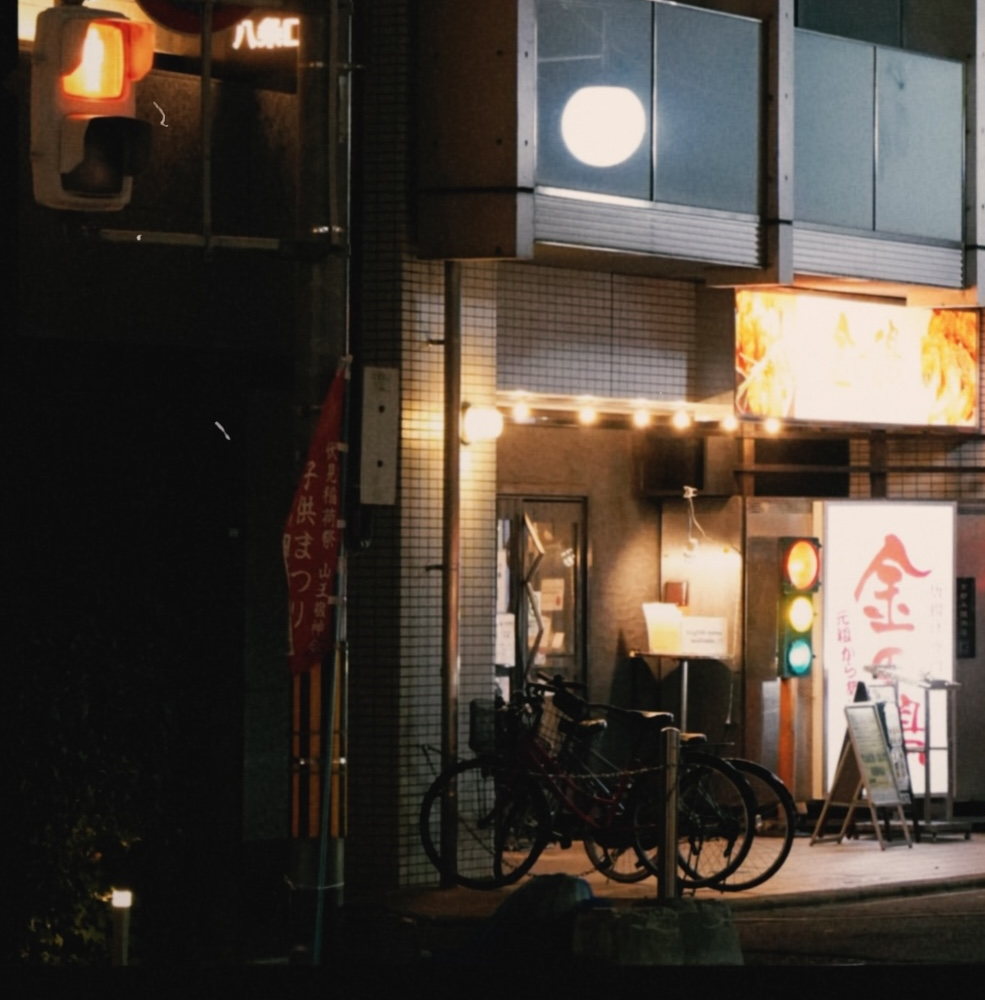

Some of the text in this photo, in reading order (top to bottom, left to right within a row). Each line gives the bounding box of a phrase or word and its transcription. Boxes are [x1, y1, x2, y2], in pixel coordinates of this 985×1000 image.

[291, 460, 318, 629] 子供まつり
